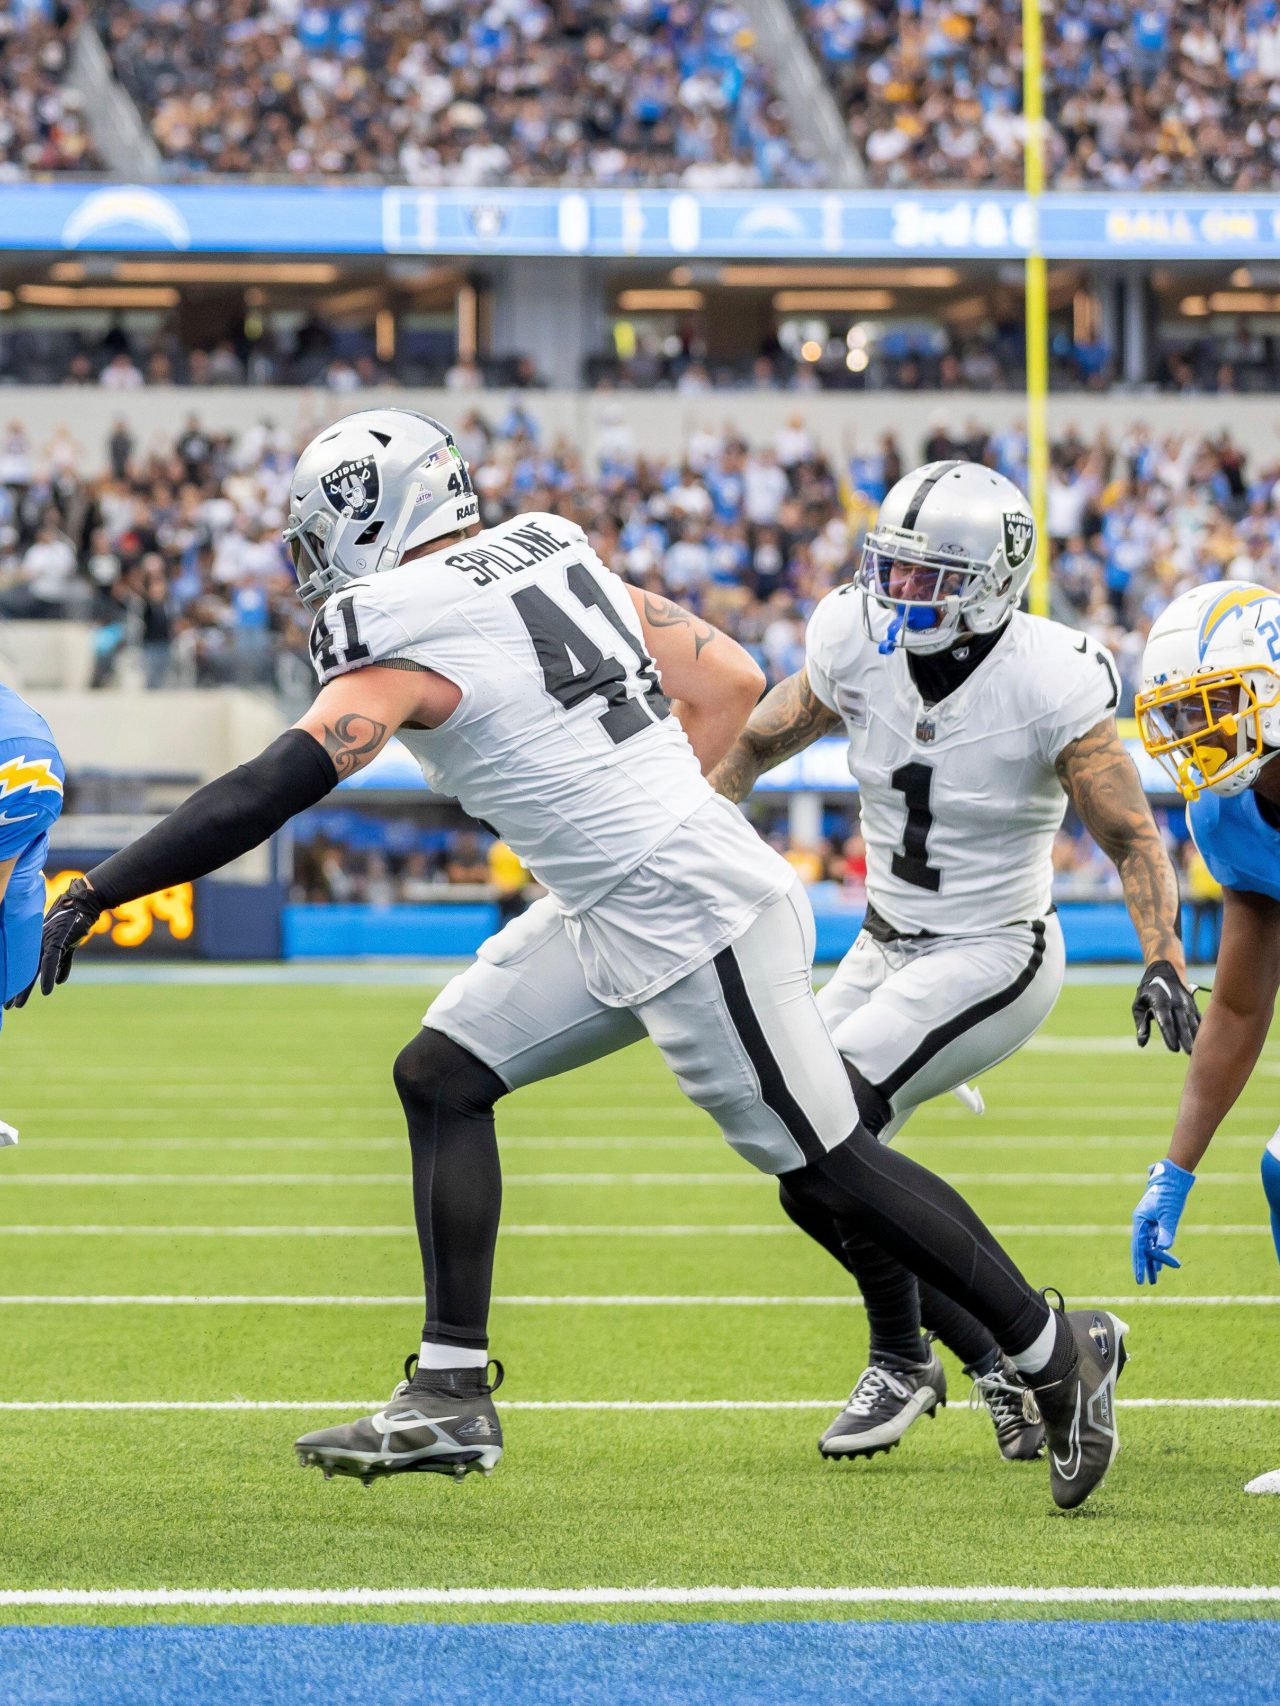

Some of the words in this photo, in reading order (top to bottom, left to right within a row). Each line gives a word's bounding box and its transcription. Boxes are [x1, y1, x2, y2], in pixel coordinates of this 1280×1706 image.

[325, 457, 370, 484] RAIDERS
[444, 521, 571, 587] SPILLANE
[309, 594, 374, 672] 41
[511, 560, 672, 745] 41
[1096, 651, 1118, 710] 1
[891, 761, 943, 893] 1
